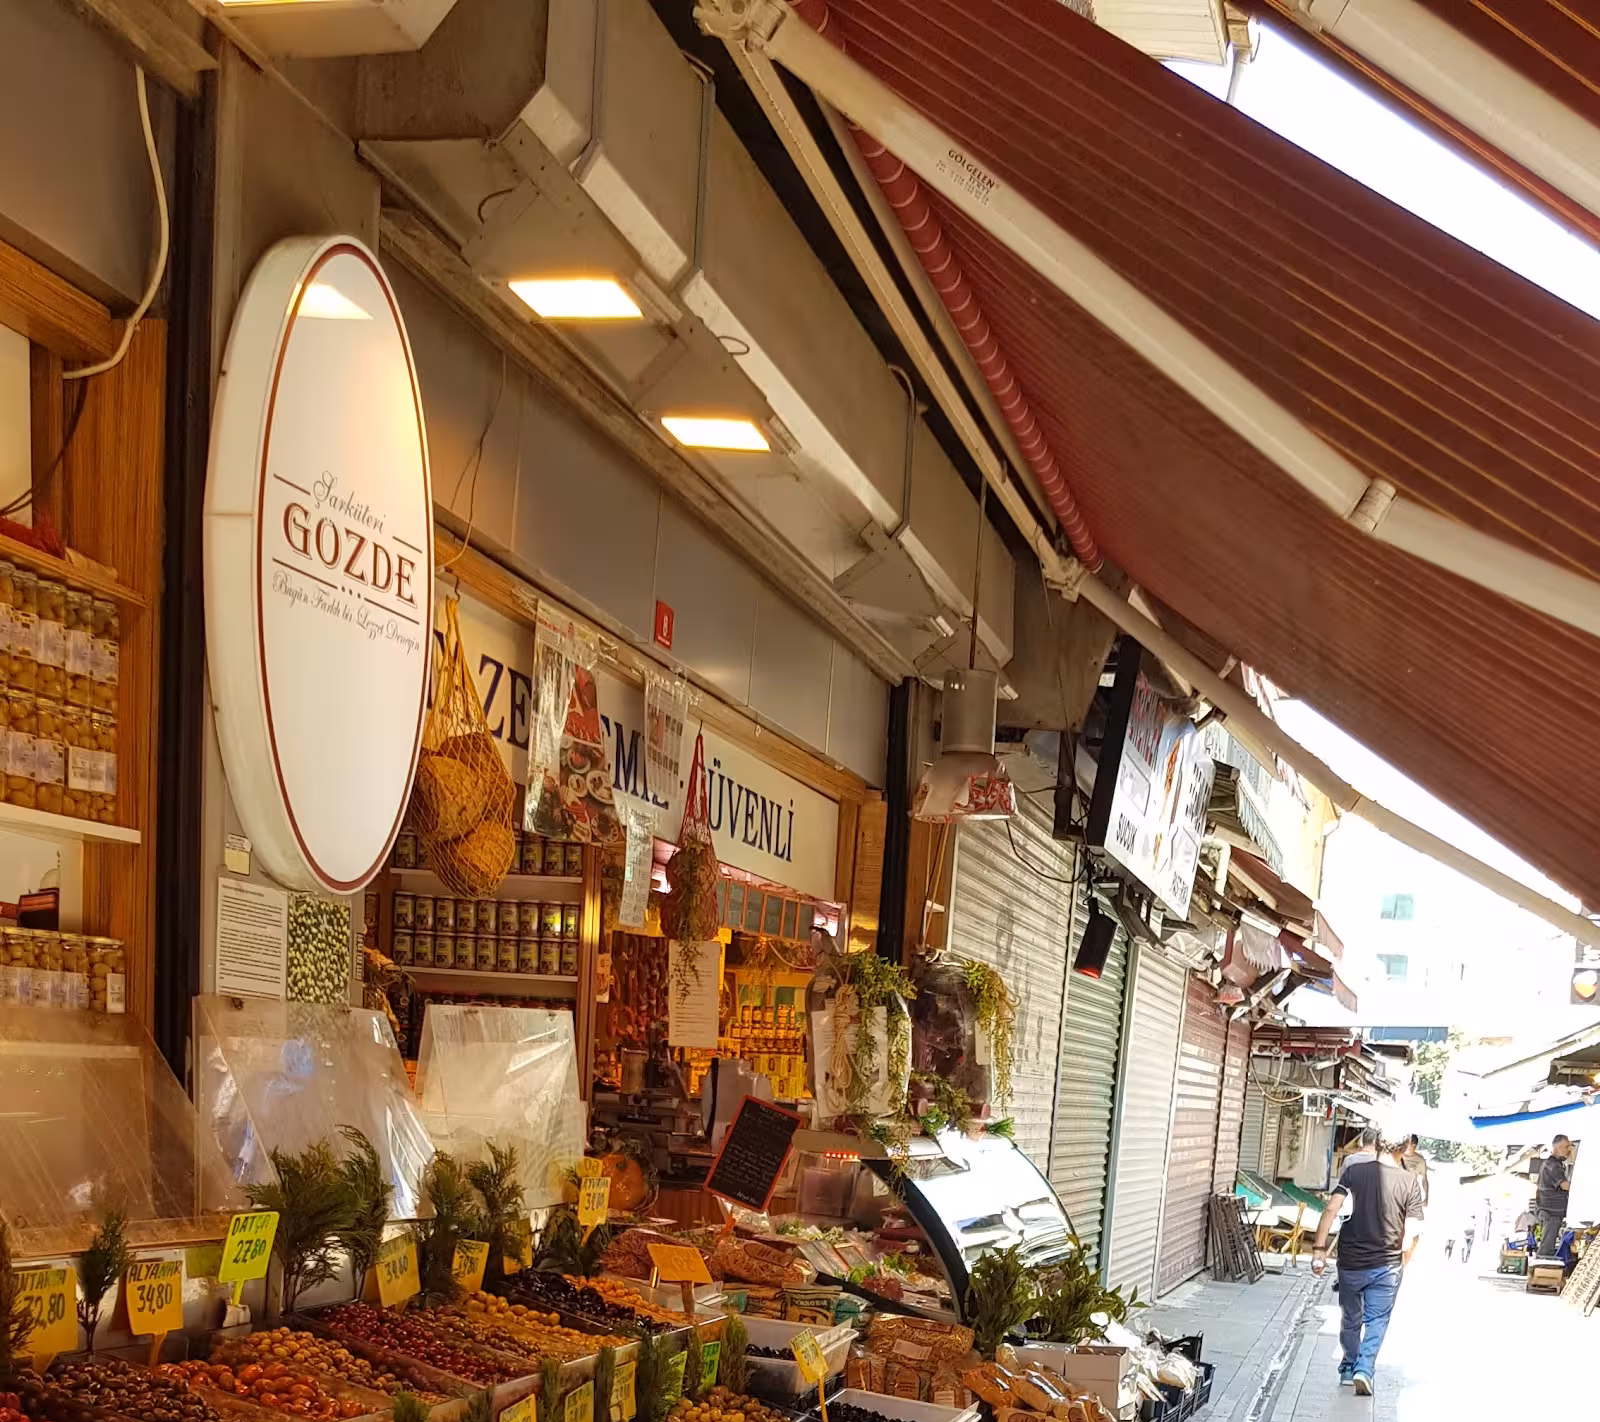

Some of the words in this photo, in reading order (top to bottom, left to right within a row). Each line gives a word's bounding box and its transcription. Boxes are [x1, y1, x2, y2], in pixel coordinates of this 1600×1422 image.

[283, 502, 418, 609] GÖZDE
[313, 470, 386, 535] Şarküteri
[705, 757, 795, 863] ÜVENLİ
